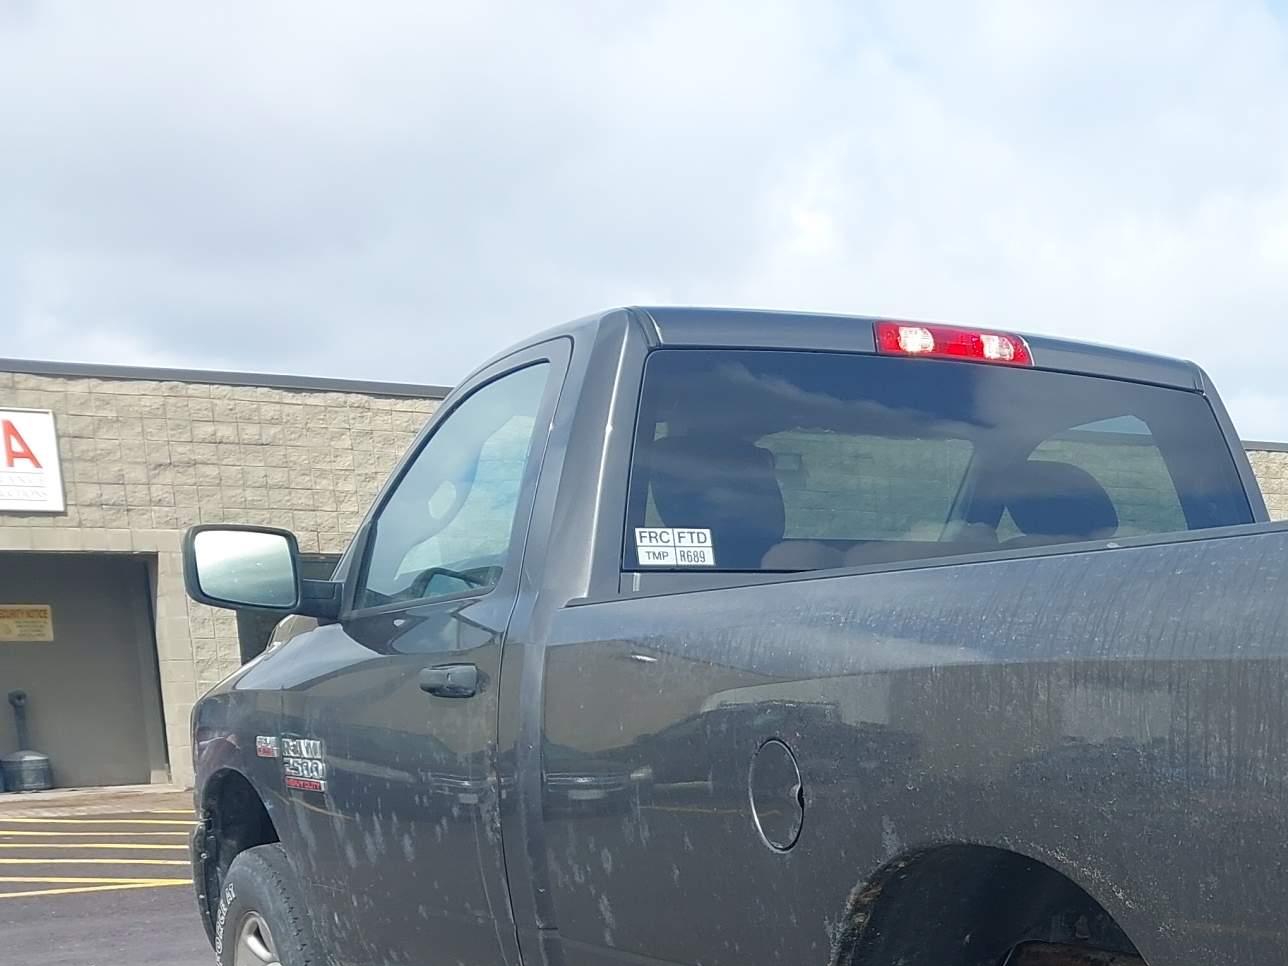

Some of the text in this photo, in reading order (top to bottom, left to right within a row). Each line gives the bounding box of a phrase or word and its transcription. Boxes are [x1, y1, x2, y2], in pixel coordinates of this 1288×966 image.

[1, 419, 43, 468] A
[638, 530, 708, 544] FRC FTD
[645, 549, 706, 563] TMP R689
